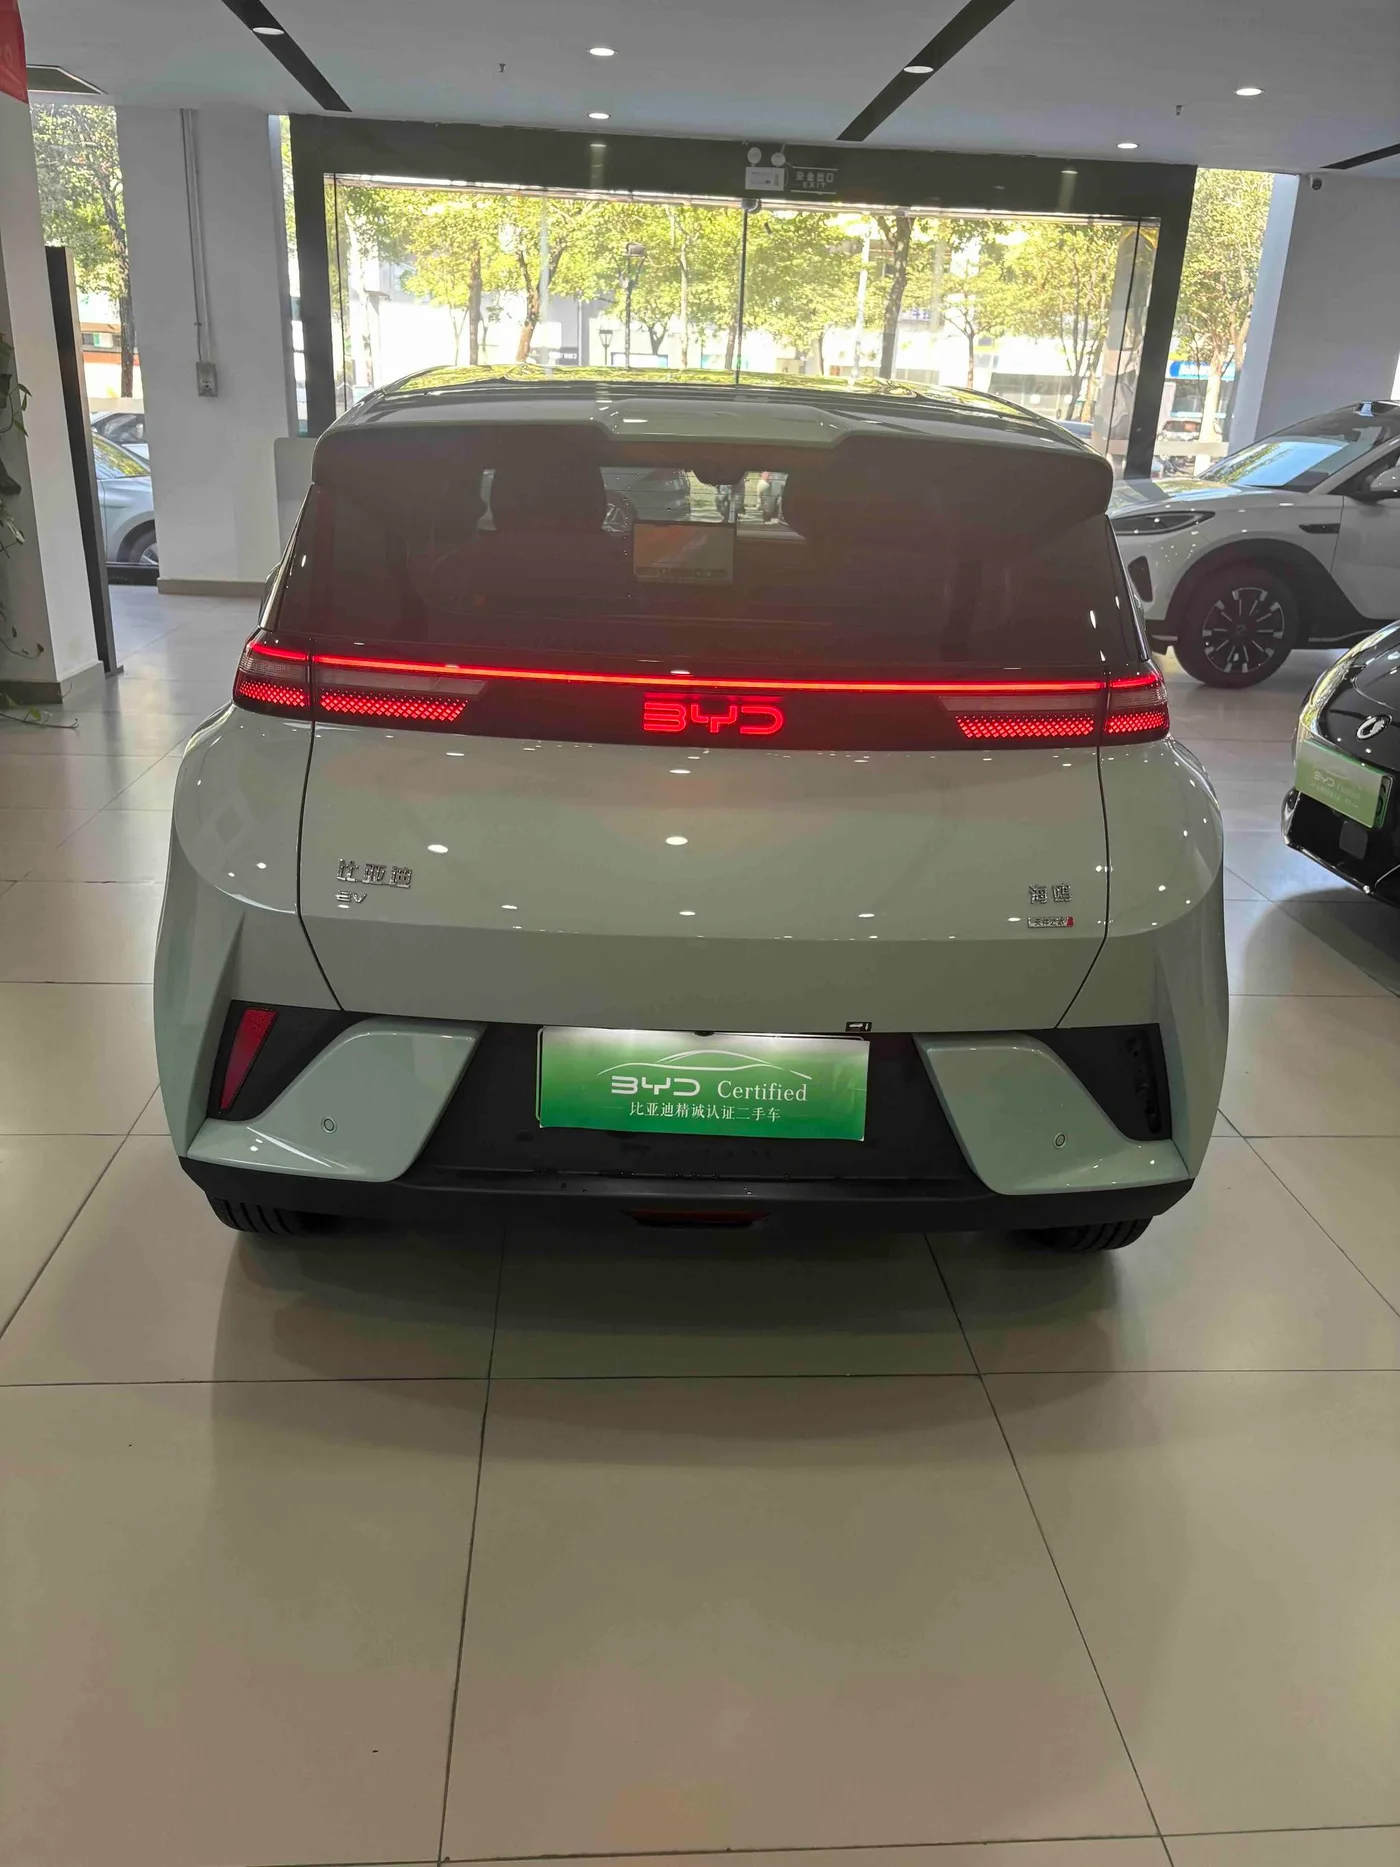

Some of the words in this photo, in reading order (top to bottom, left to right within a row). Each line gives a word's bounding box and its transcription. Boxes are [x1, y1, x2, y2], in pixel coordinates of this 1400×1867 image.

[802, 181, 826, 189] EXIT
[643, 702, 784, 735] BYD
[336, 858, 413, 888] 比亚迪
[336, 890, 368, 904] EV
[611, 1075, 700, 1097] BYD
[717, 1080, 807, 1101] Certified
[629, 1101, 781, 1122] 比亚迪精诚认证二手车
